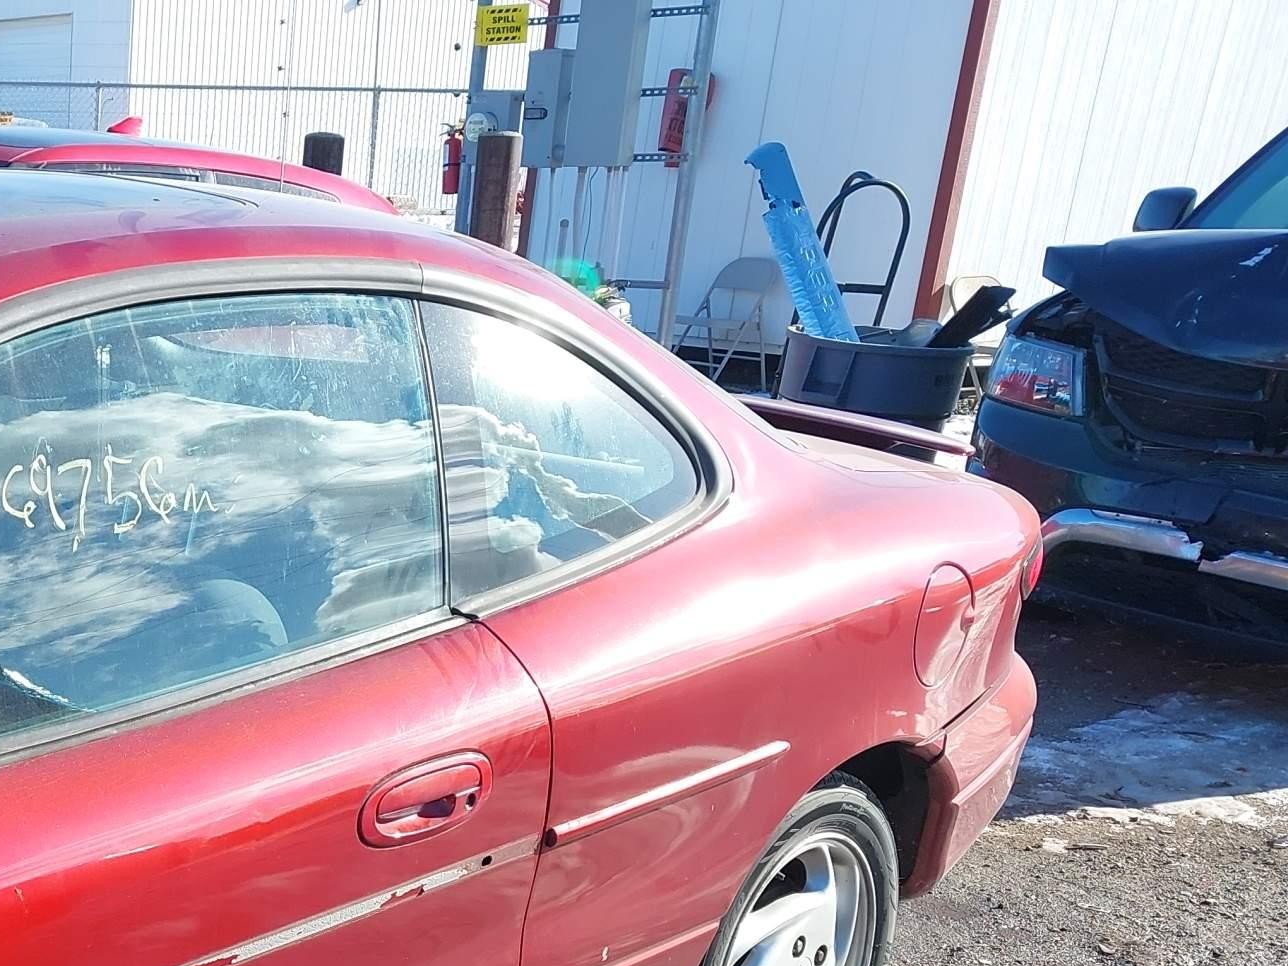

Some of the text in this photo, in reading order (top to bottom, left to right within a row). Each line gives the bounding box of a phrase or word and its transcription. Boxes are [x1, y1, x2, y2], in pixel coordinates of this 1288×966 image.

[492, 15, 516, 24] SPILL
[485, 25, 521, 35] STATION
[1, 450, 178, 546] 69756
